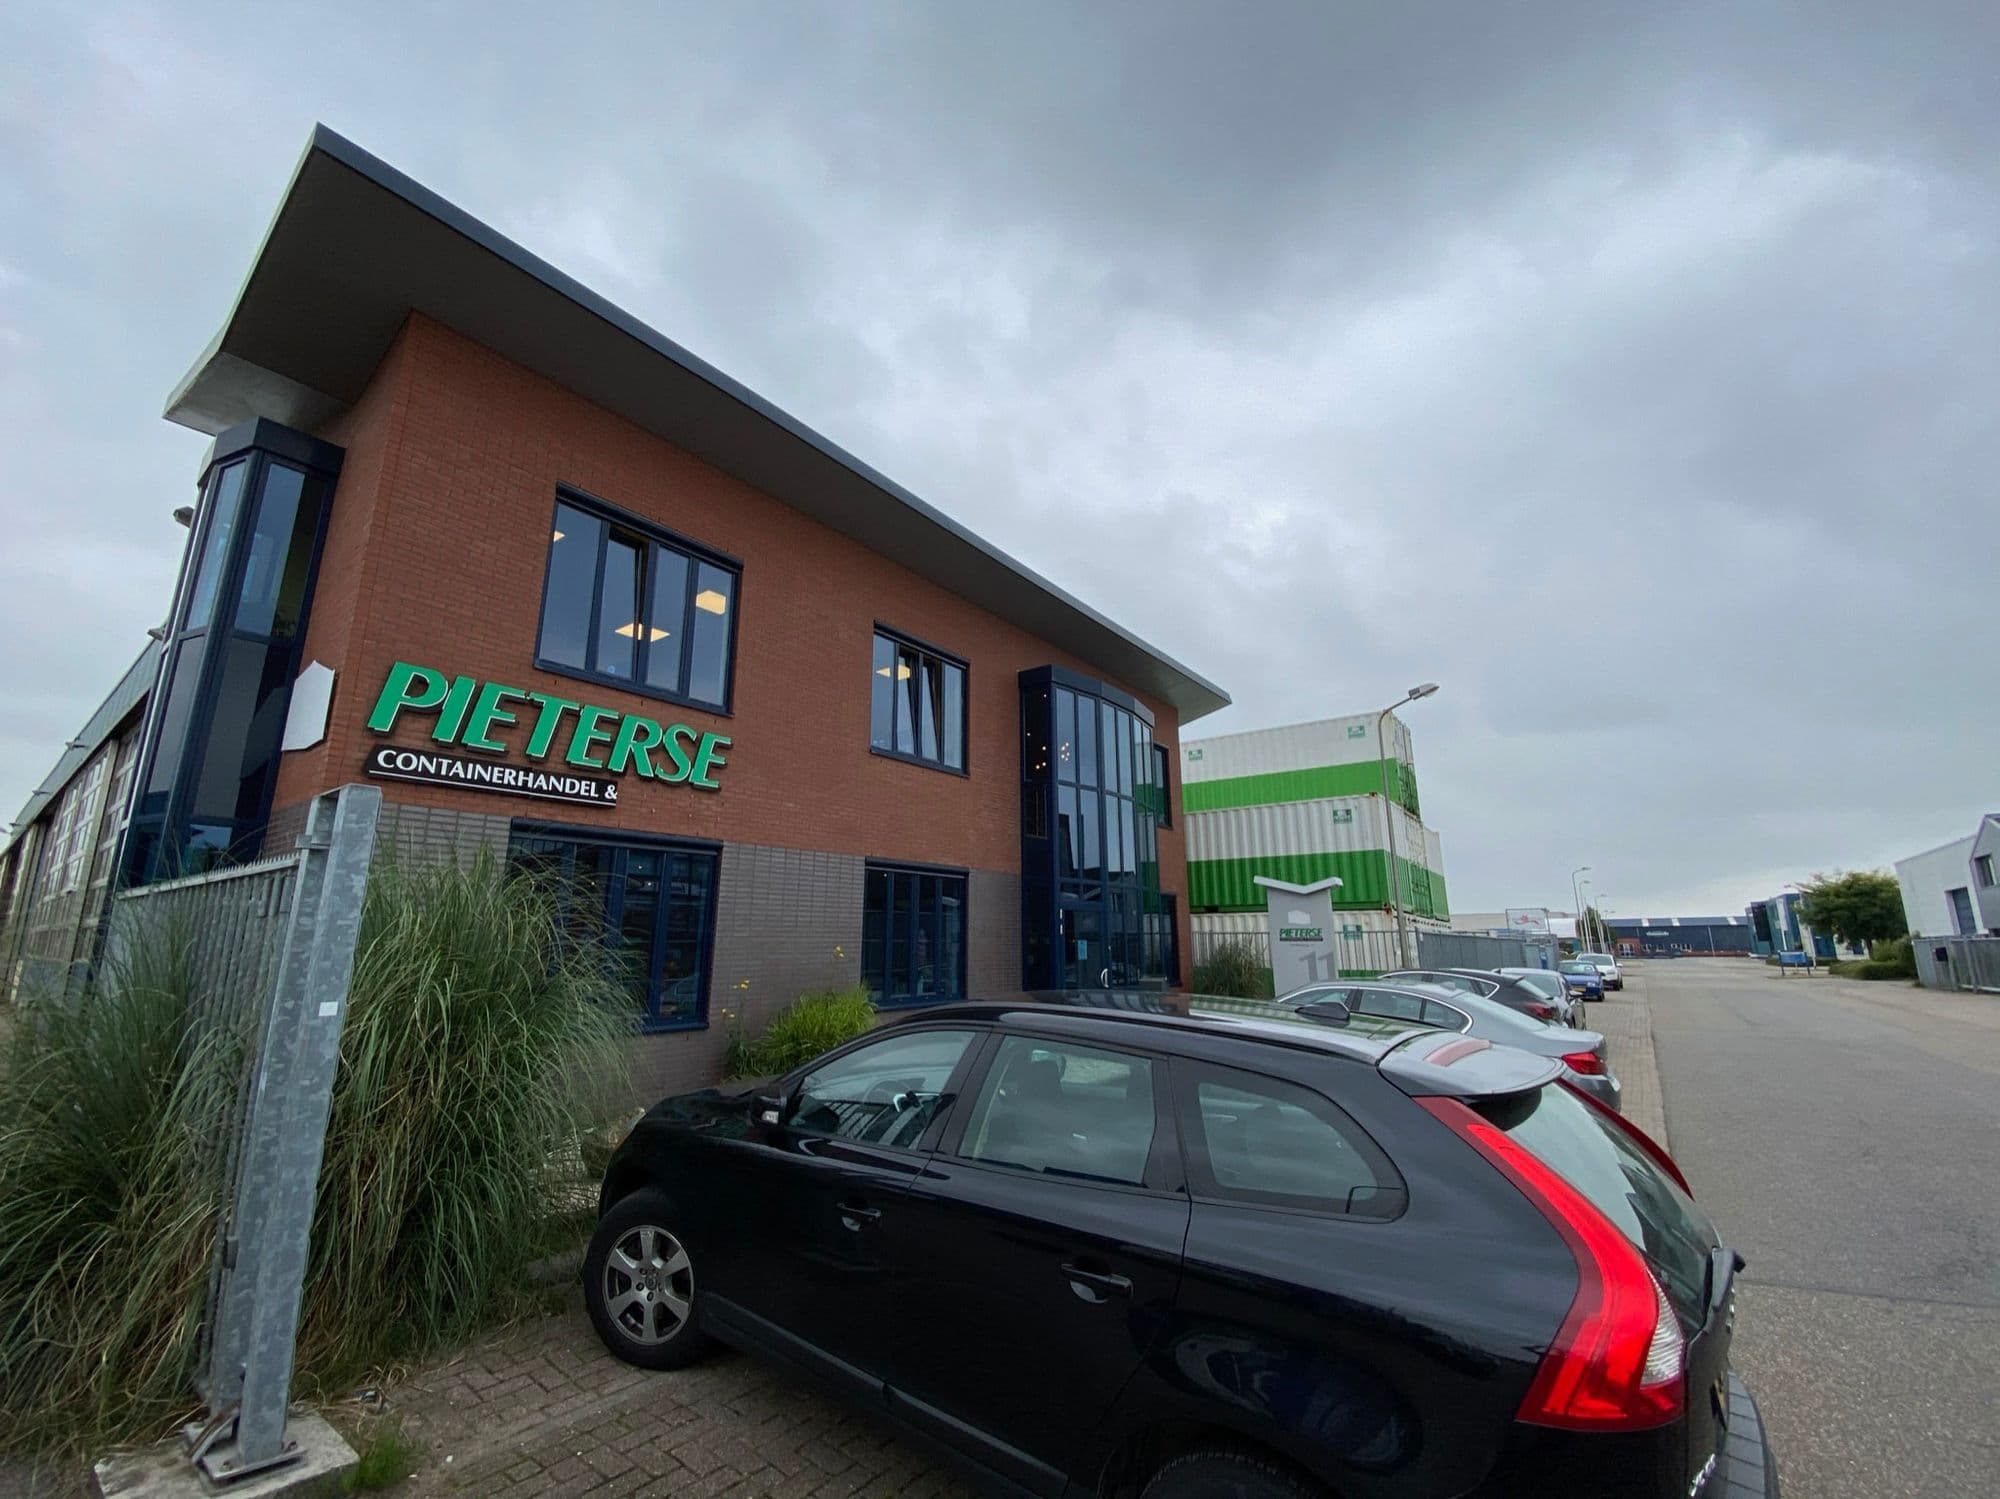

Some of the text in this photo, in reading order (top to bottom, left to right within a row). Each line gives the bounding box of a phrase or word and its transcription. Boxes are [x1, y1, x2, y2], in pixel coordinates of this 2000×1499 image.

[367, 662, 733, 788] PIETERSE
[377, 750, 619, 801] CONTAINERHANDEL &
[1279, 927, 1323, 937] PIETERSE
[1298, 951, 1337, 983] 11
